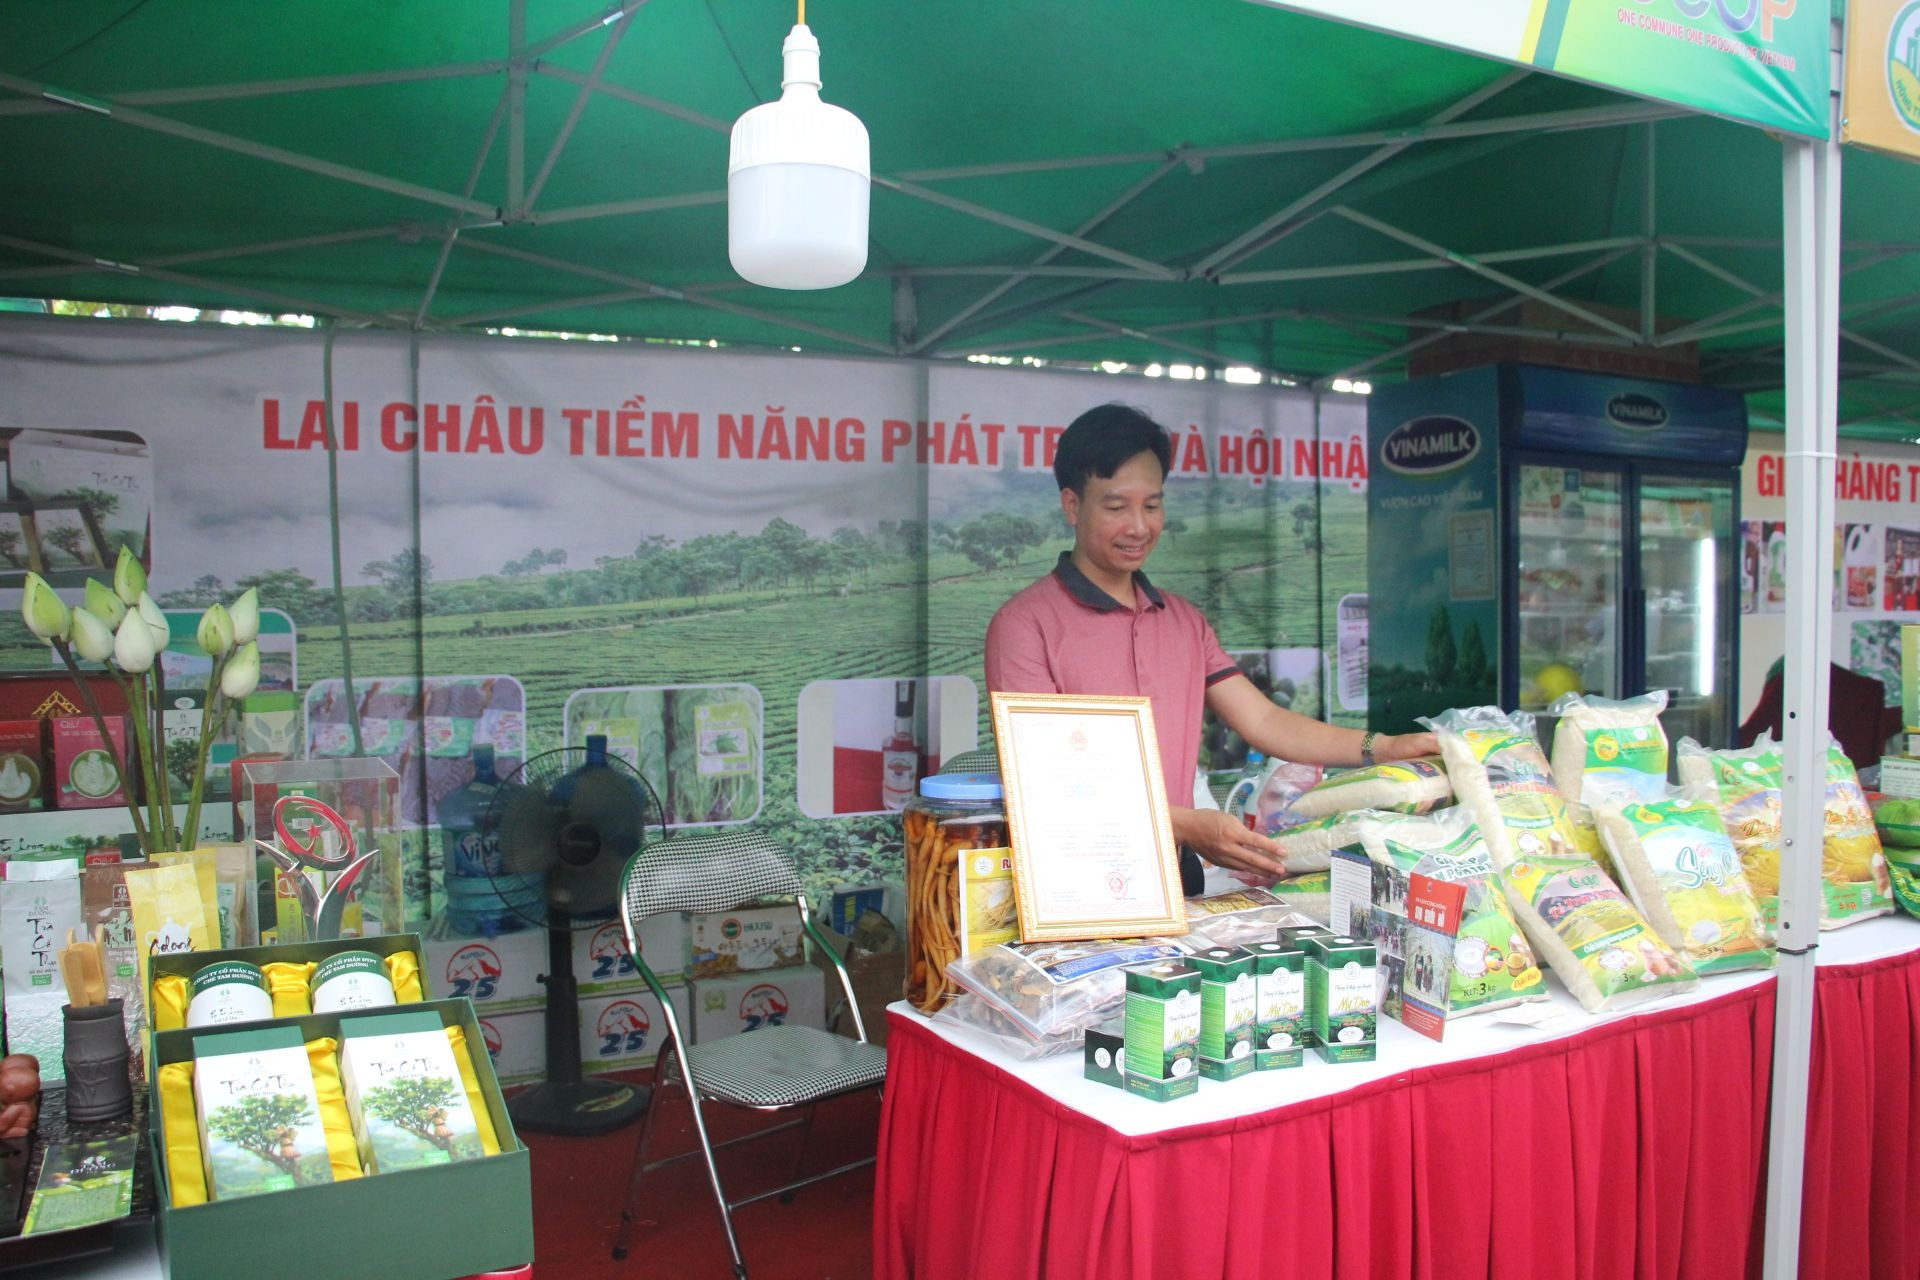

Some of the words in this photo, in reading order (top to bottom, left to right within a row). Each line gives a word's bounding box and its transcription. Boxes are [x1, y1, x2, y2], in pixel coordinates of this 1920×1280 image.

[1617, 8, 1637, 26] ONE
[1639, 14, 1684, 40] COMMUNE
[1686, 27, 1704, 45] ONE
[1706, 34, 1746, 56] PRODUCT
[1759, 48, 1796, 72] VIETNAM
[1610, 401, 1664, 420] VINAMILK
[263, 398, 358, 450] LAI
[380, 394, 545, 455] CHÂU
[561, 394, 700, 458] TIỀM
[717, 405, 866, 463] NĂNG
[882, 413, 1005, 466] PHÁT
[1219, 428, 1282, 484] HỘI
[1294, 434, 1368, 488] NHẬ
[1389, 429, 1472, 459] VINAMILK
[1676, 846, 1724, 888] Séng
[209, 970, 218, 978] TY
[333, 964, 345, 972] TAM
[592, 952, 637, 979] 25
[1622, 973, 1629, 982] 3
[203, 976, 217, 985] CHÈ
[217, 973, 231, 981] TAM
[448, 975, 500, 1000] 25
[1479, 983, 1487, 996] 3
[600, 1029, 648, 1055] 25
